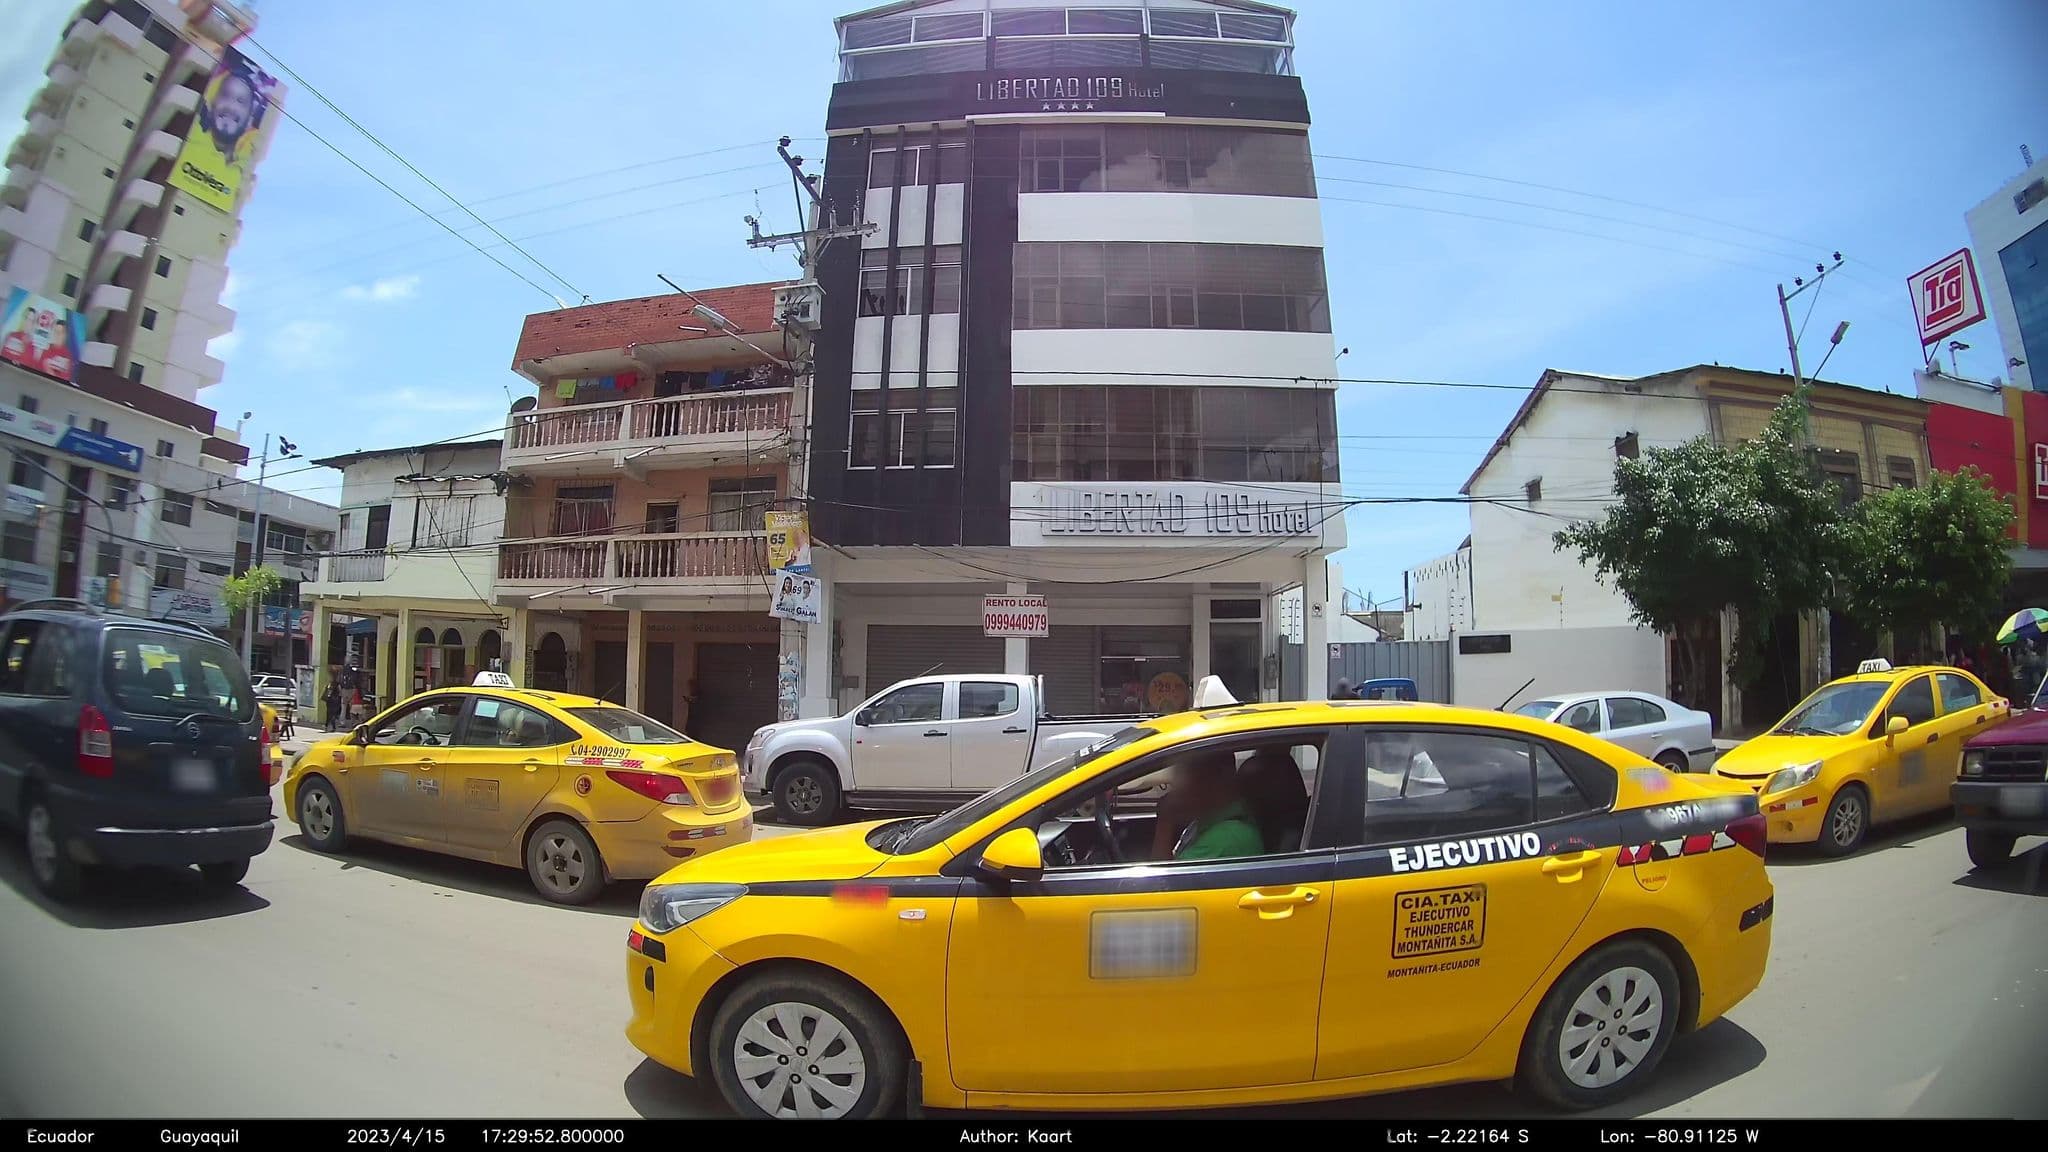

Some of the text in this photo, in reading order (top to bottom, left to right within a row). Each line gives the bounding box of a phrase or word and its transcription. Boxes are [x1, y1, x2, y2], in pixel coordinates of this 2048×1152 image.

[977, 77, 1165, 101] LIBERTAD 109 Hotel
[1049, 490, 1311, 533] LIBERTAD 109 Hotel
[770, 533, 786, 545] 65
[985, 599, 1048, 608] RENTO LOCAL
[984, 613, 1047, 631] 0999440979
[1862, 661, 1881, 673] TAXI
[578, 744, 631, 758] 04-2902997
[1389, 832, 1541, 872] EJECUTIVO
[1410, 905, 1470, 923] EJECUTIVO
[1404, 920, 1474, 938] THUNDERCAR
[1397, 936, 1457, 954] MONTAÑITA
